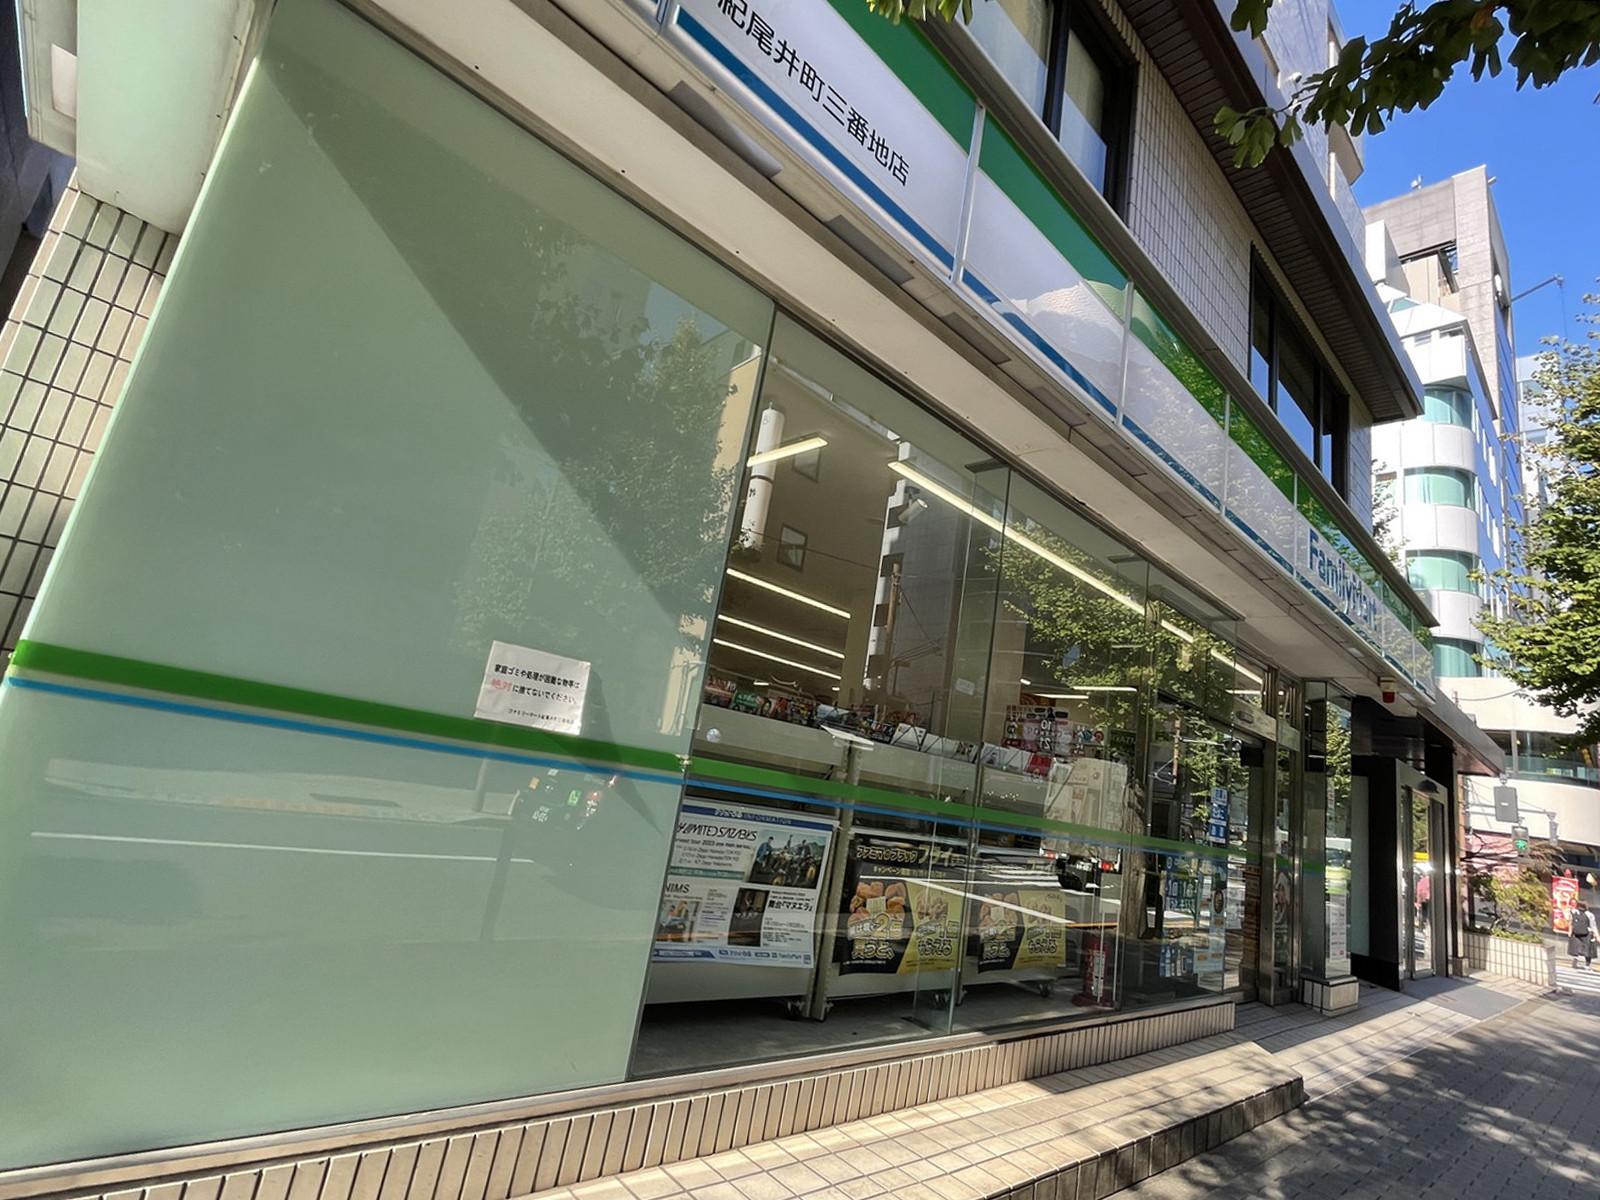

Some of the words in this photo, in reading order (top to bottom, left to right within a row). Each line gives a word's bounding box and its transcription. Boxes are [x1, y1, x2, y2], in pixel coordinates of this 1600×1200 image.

[717, 0, 910, 187] 紀尾井町三番地店
